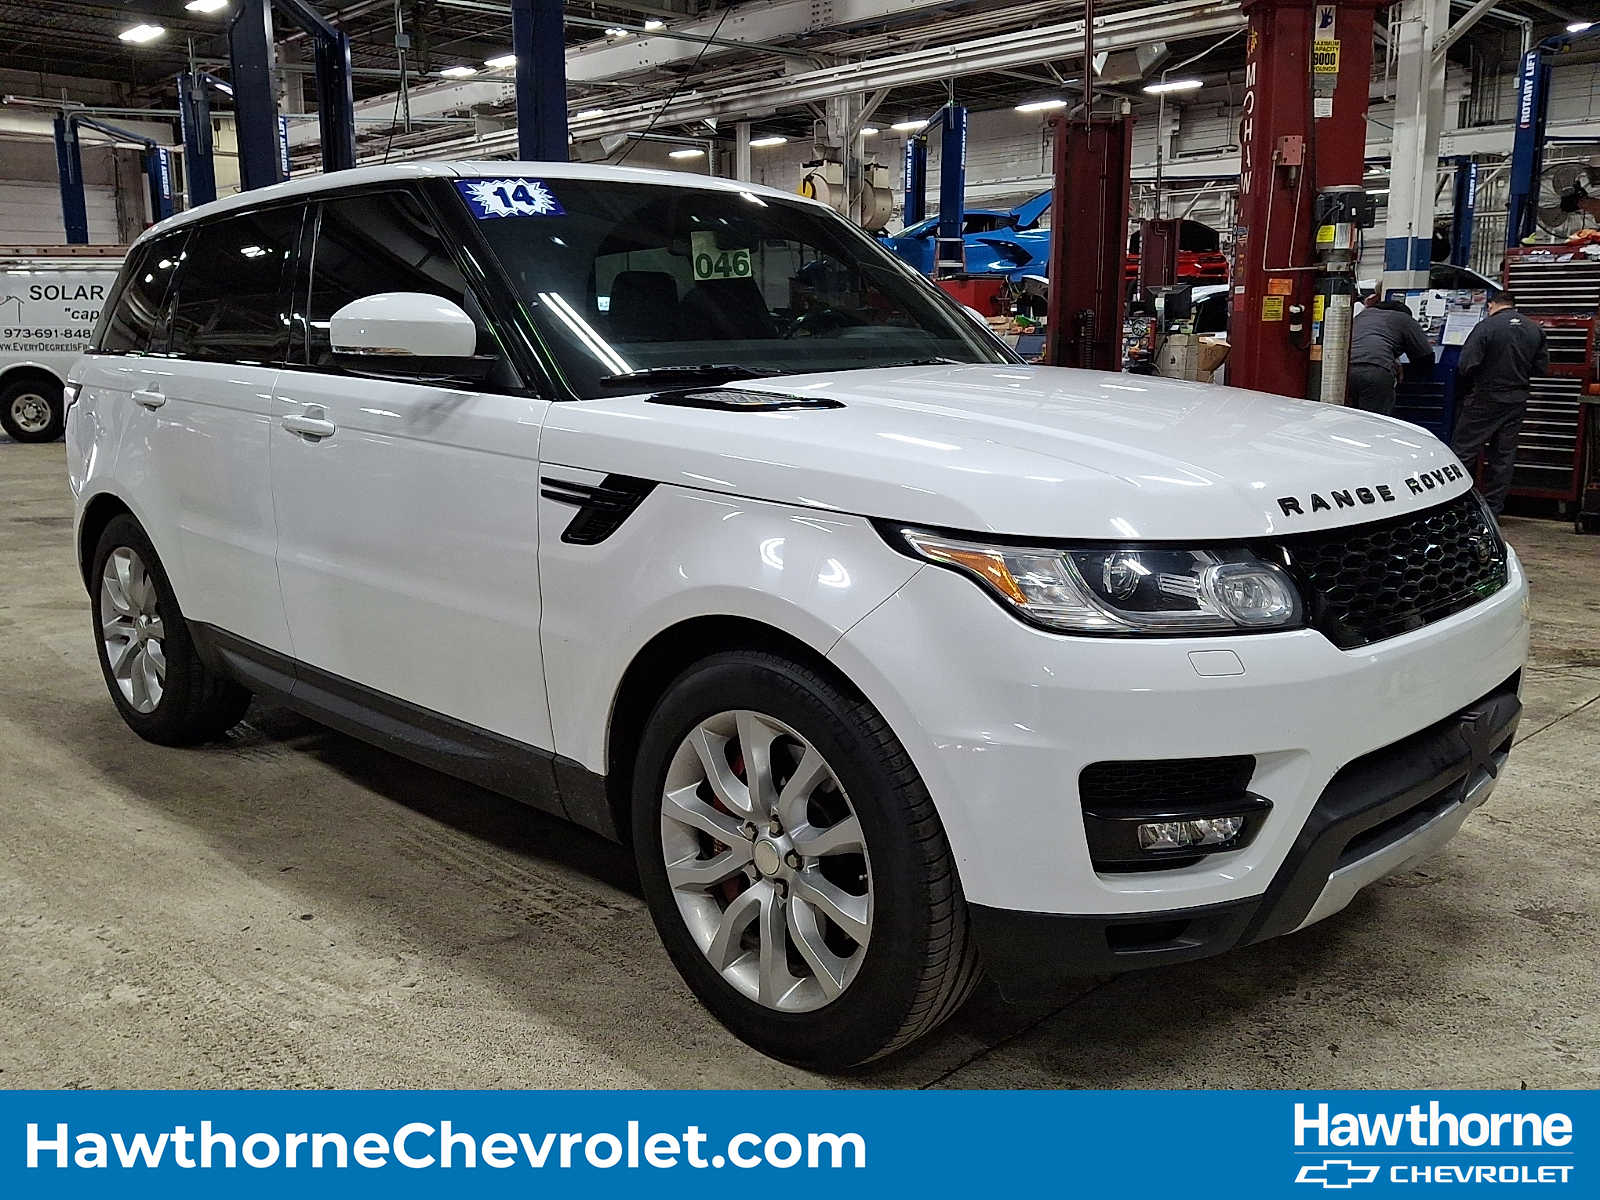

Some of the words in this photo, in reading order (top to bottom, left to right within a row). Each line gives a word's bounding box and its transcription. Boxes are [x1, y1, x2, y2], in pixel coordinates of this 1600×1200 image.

[1525, 52, 1537, 77] LIFT
[1520, 79, 1534, 124] ROTARY
[279, 136, 288, 172] ROTARY
[492, 184, 536, 208] 14
[694, 252, 750, 279] 046
[29, 284, 105, 301] SOLAR
[4, 328, 95, 339] 973-691-848
[1277, 484, 1396, 516] RANGE
[1404, 463, 1464, 496] ROVER
